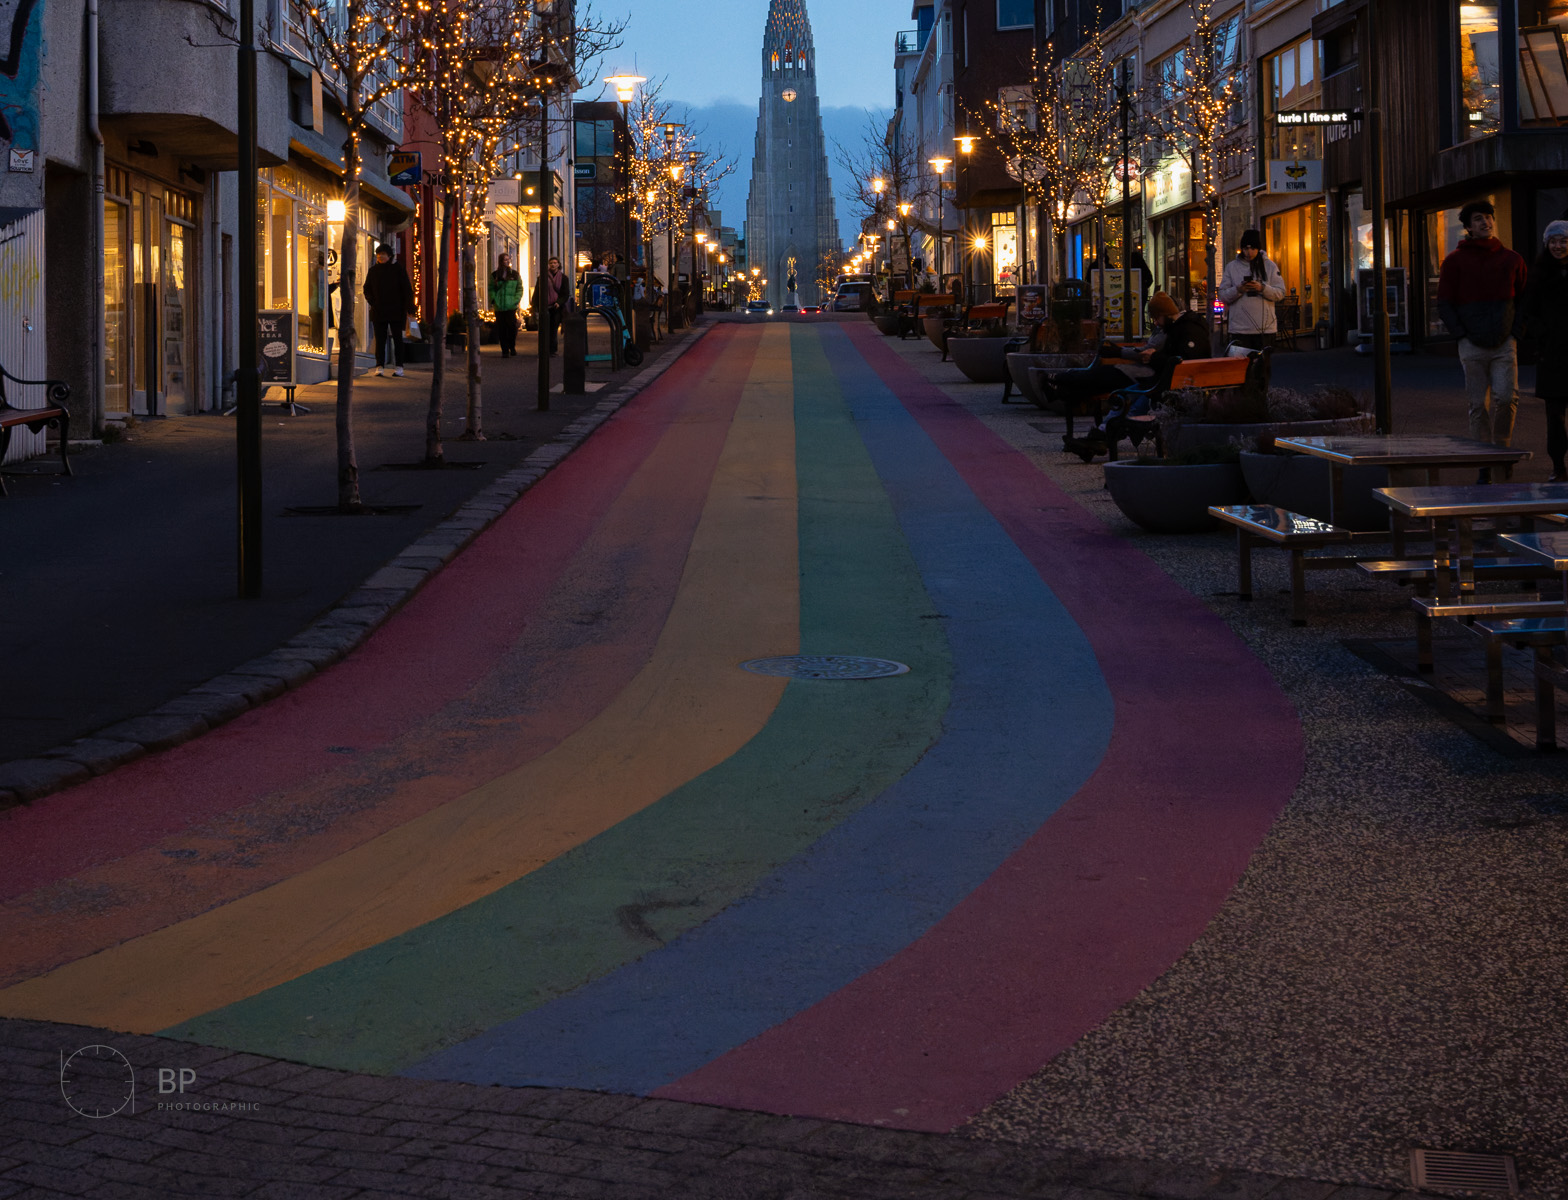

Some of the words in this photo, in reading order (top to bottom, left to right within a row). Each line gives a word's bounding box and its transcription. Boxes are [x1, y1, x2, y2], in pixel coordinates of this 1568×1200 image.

[1309, 112, 1331, 122] fine
[1331, 112, 1348, 122] art
[393, 155, 416, 163] ATM
[261, 324, 278, 332] ICE
